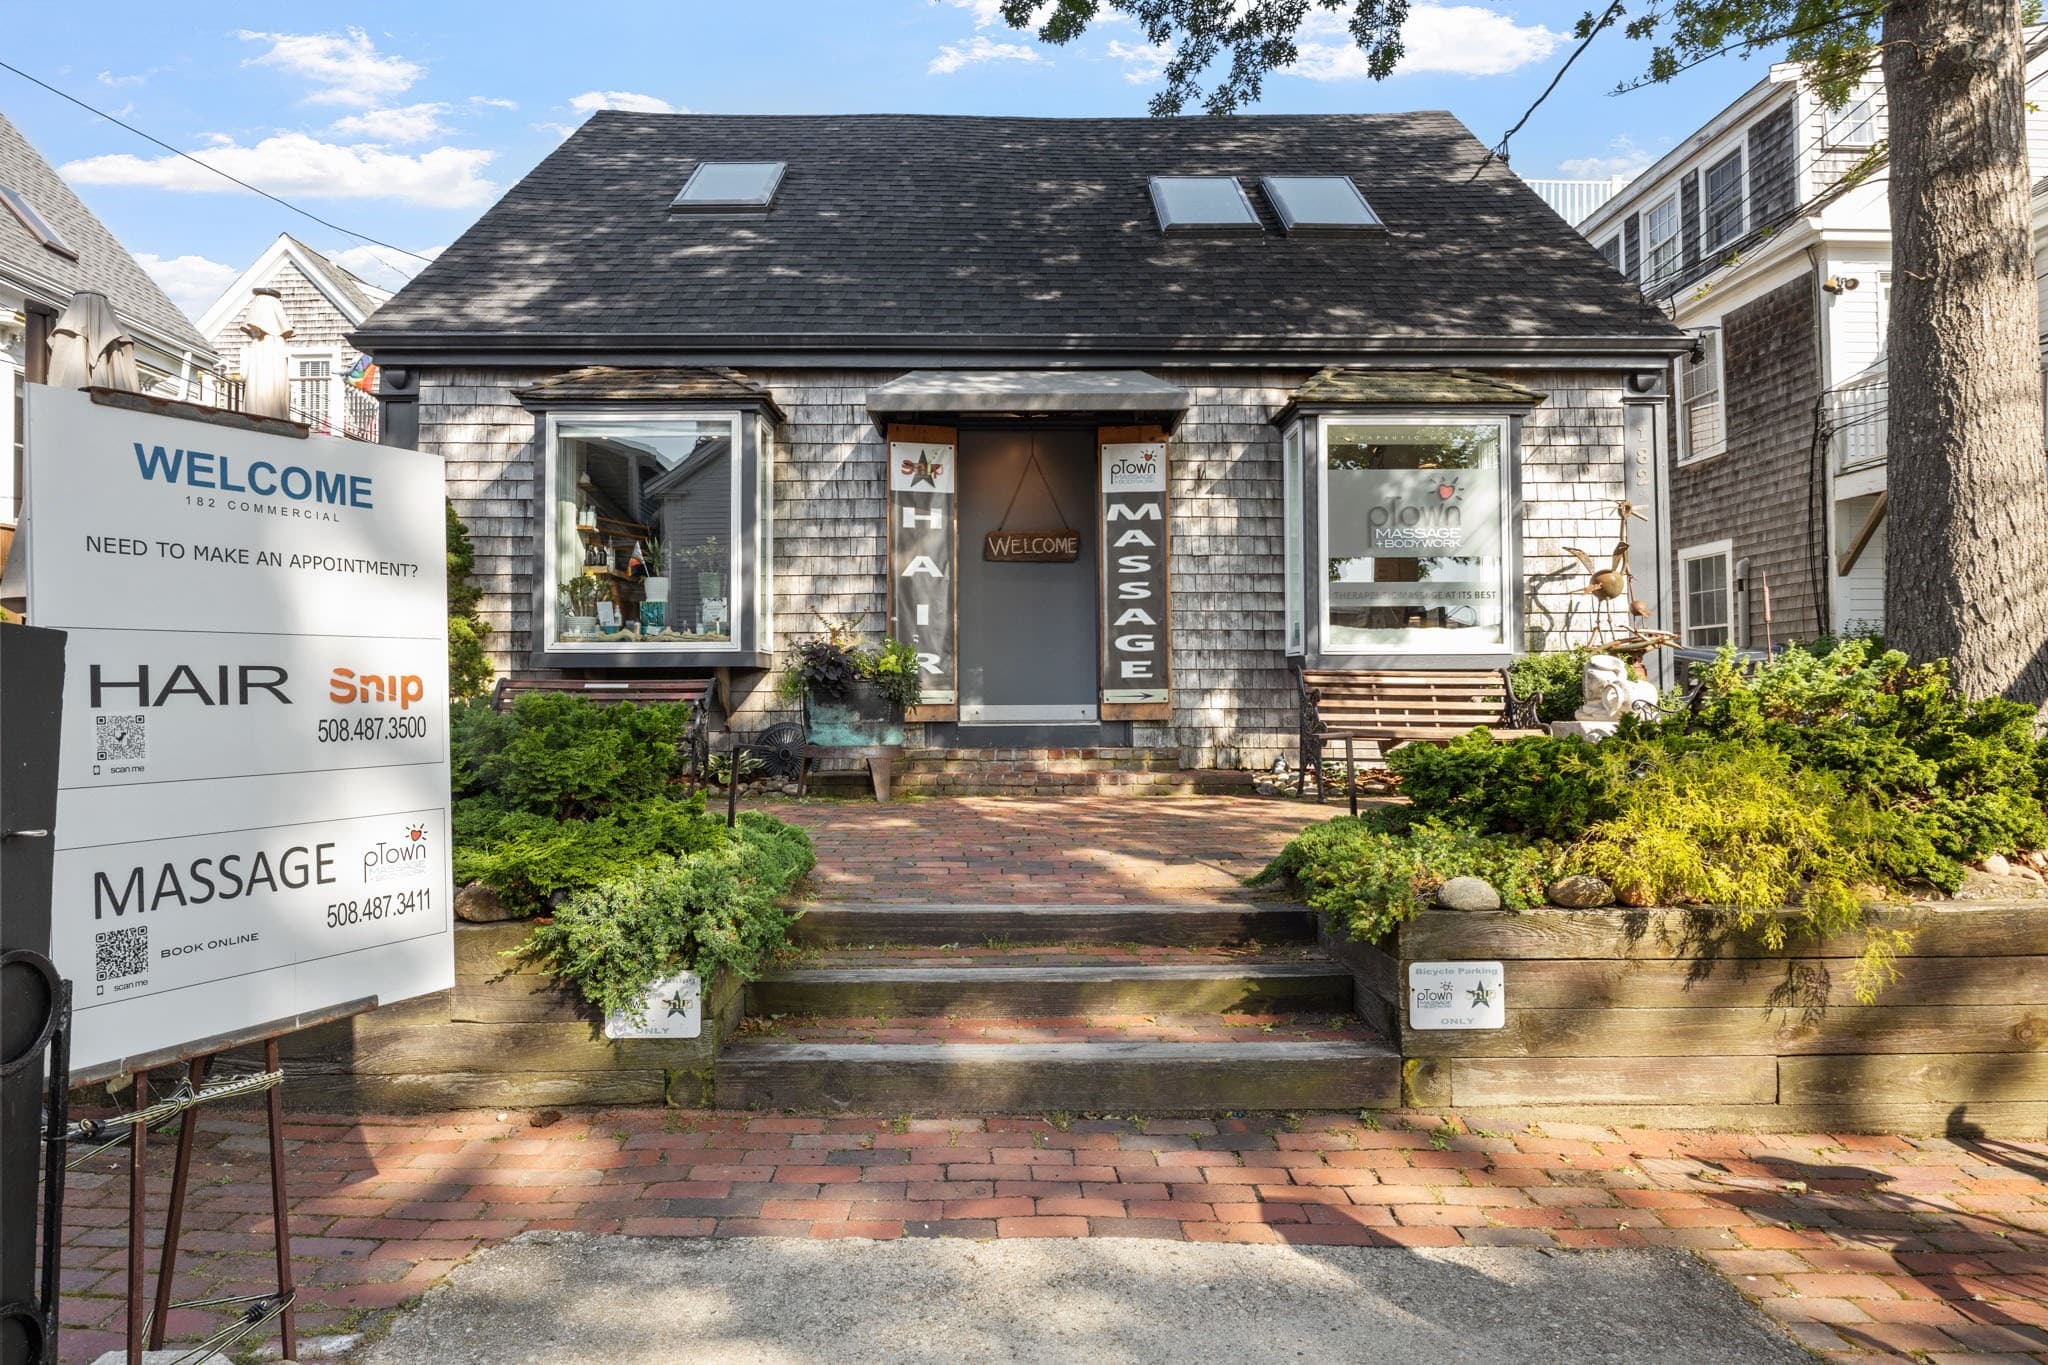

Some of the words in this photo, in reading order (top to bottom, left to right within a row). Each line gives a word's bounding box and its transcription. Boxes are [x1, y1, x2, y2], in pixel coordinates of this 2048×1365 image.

[133, 443, 374, 510] WELCOME
[186, 496, 216, 509] 182
[228, 501, 340, 523] COMMERCIAL
[988, 535, 1079, 557] WELCOME
[1375, 527, 1462, 539] MASSAGE
[86, 536, 148, 556] NEED
[156, 541, 186, 559] TO
[194, 545, 250, 565] MAKE
[256, 551, 282, 567] AN
[289, 554, 419, 577] APPOINTMENT?
[901, 507, 945, 675] HAIR
[1106, 503, 1163, 679] MASSAGE
[1458, 591, 1472, 600] ITS
[1474, 591, 1497, 600] BEST
[89, 663, 294, 708] HAIR
[329, 667, 424, 710] Snip
[317, 716, 427, 743] 508.487.3500
[110, 766, 130, 774] scan
[131, 765, 145, 773] me
[363, 842, 427, 885] pTown
[94, 843, 337, 921] MASSAGE
[326, 887, 431, 928] 508.487.3411
[161, 942, 205, 958] BOOK
[207, 932, 260, 950] ONLINE
[1415, 967, 1455, 976] Bicycle
[1458, 967, 1498, 976] Parking
[113, 982, 135, 992] scan
[135, 979, 149, 989] me
[635, 1027, 670, 1035] ONLY
[1440, 1017, 1475, 1025] ONLY
